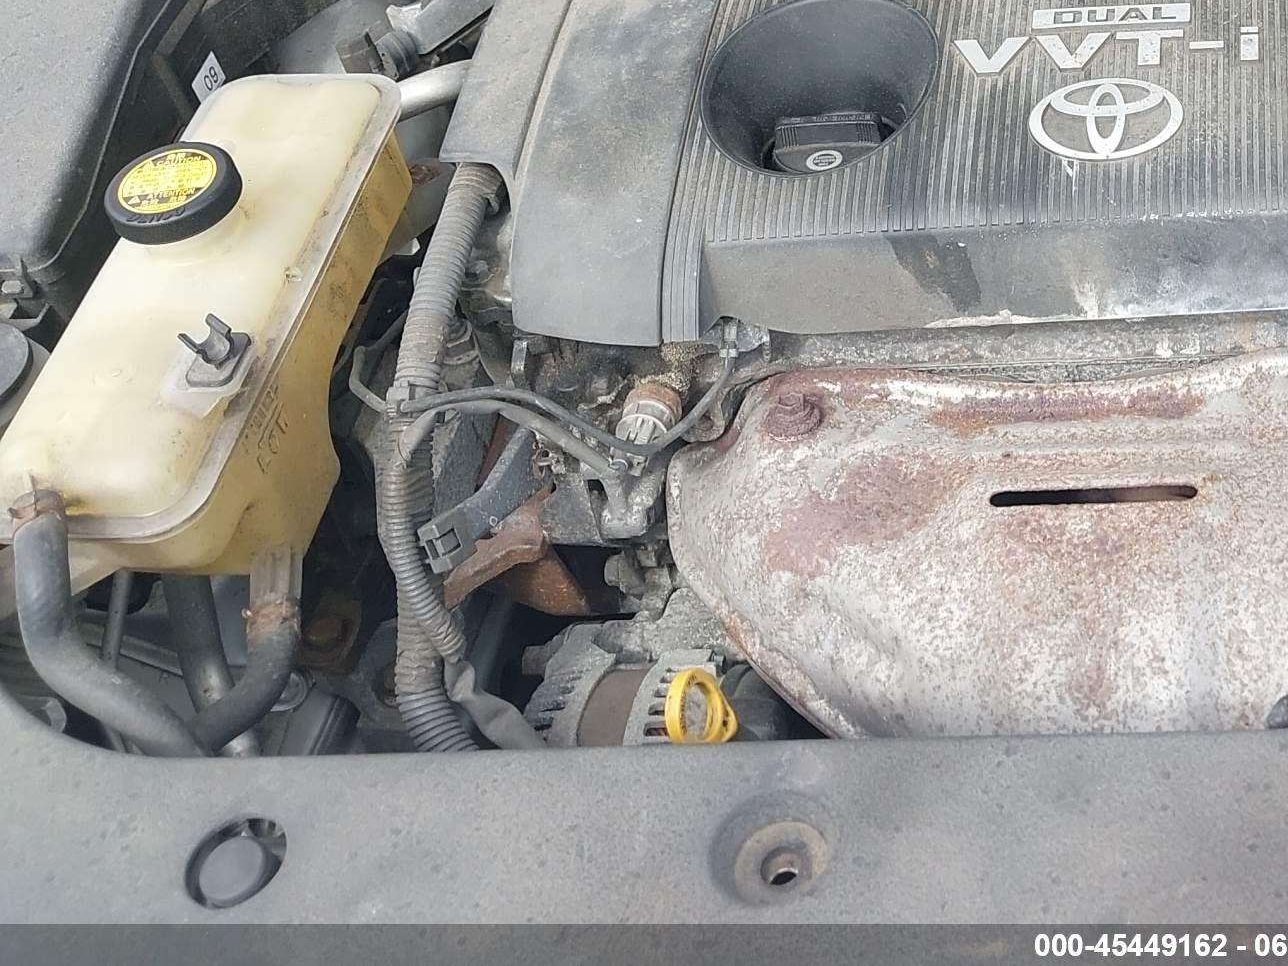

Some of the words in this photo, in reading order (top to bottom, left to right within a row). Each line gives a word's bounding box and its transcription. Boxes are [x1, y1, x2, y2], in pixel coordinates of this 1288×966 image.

[1053, 6, 1177, 25] DUAL
[953, 25, 1259, 75] VVT-i
[157, 155, 202, 166] CAUTION
[146, 187, 197, 200] ATTENTION
